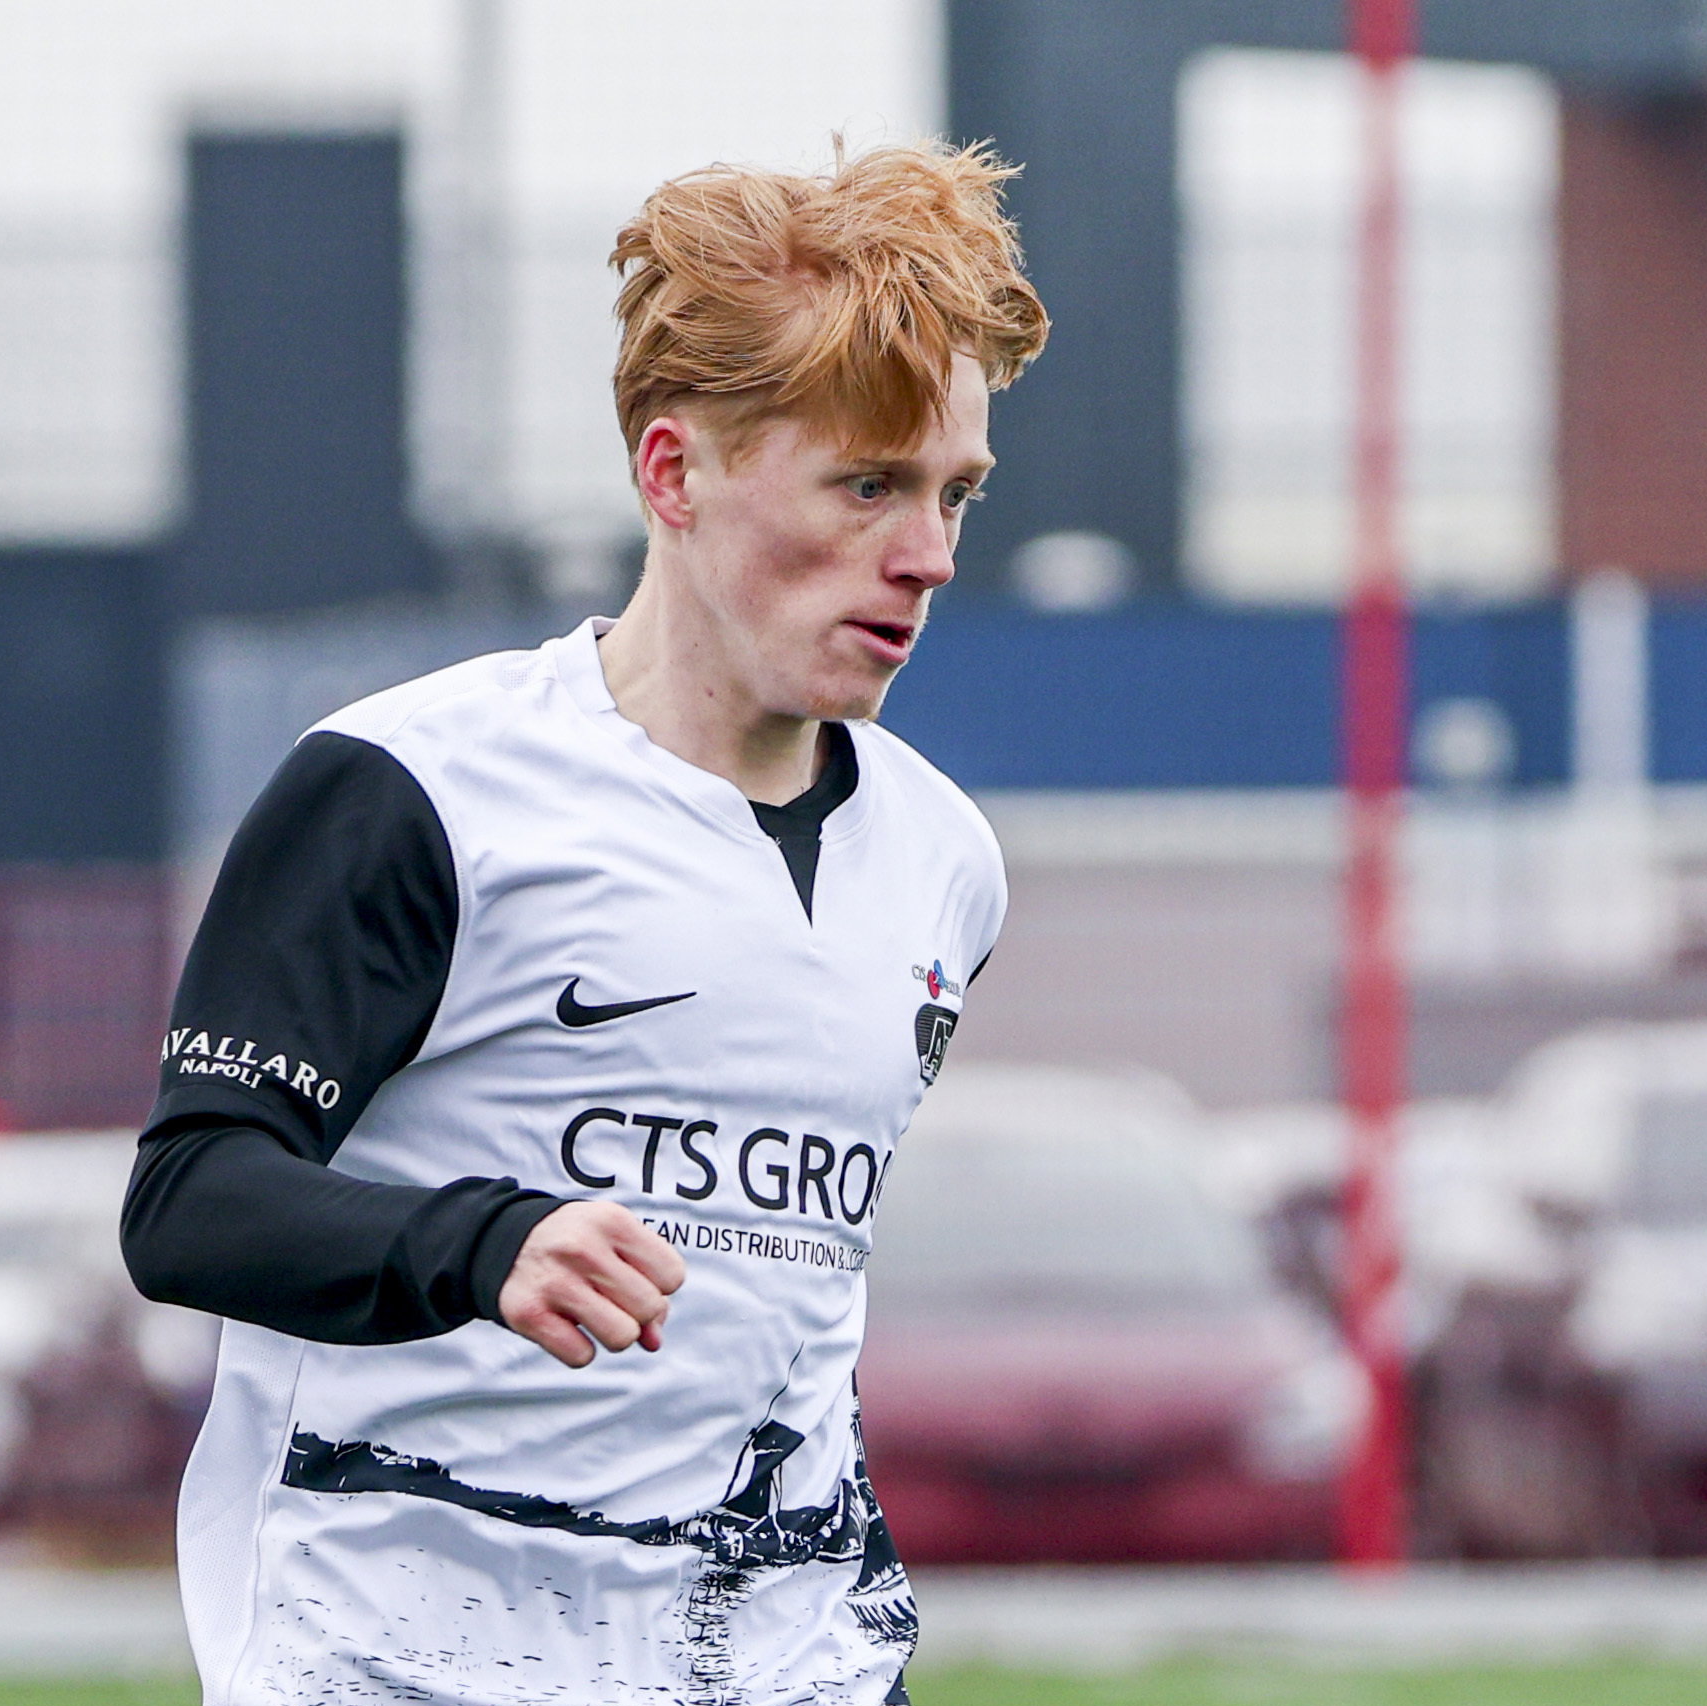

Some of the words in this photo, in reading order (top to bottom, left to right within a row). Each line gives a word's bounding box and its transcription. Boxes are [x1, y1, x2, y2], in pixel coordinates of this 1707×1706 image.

[179, 1058, 263, 1089] NAPOLI
[560, 1107, 718, 1201] CTS
[696, 1224, 836, 1269] DISTRIBUTION
